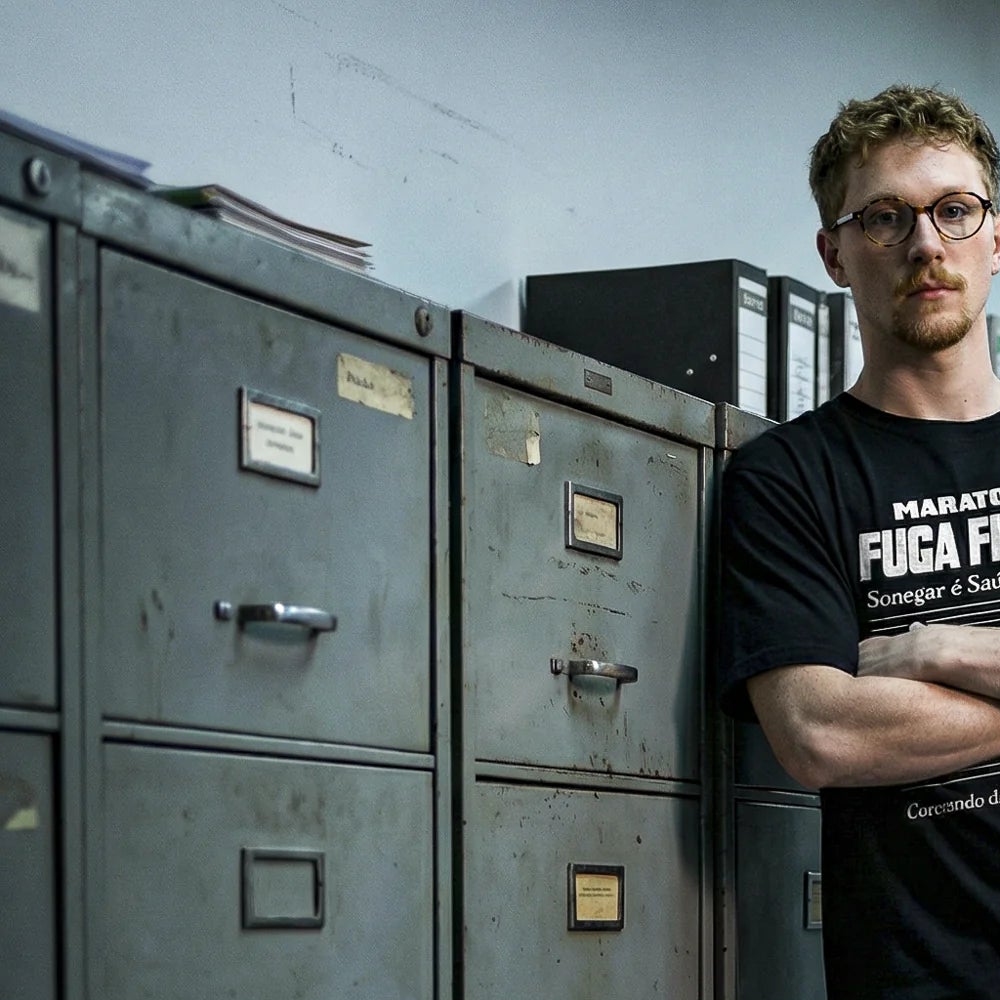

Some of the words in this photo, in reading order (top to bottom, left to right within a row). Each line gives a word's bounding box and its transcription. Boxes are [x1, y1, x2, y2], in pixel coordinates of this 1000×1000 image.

[858, 522, 961, 582] FUGA
[867, 585, 946, 607] Sonegar
[951, 579, 962, 596] é
